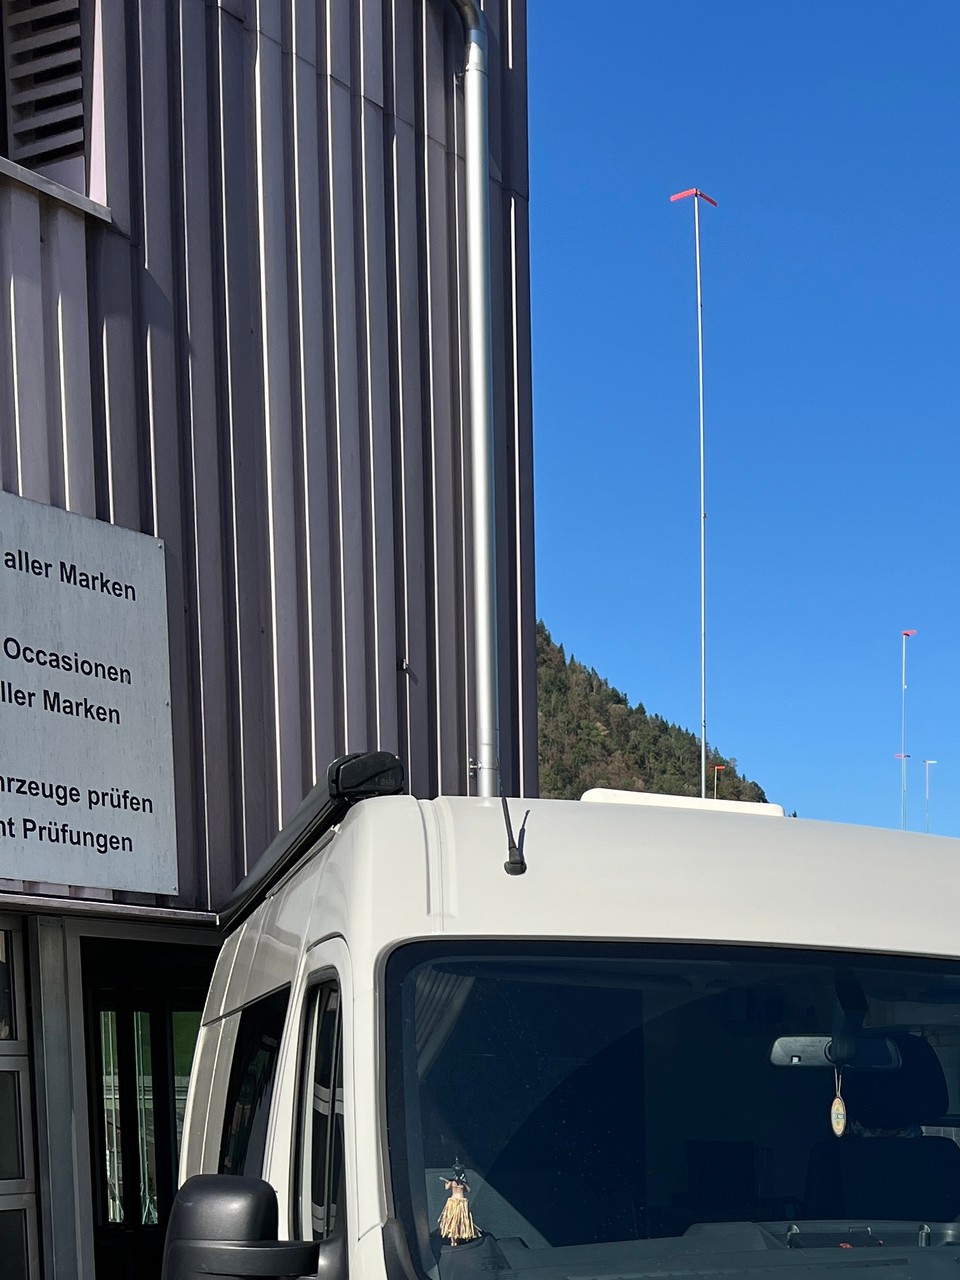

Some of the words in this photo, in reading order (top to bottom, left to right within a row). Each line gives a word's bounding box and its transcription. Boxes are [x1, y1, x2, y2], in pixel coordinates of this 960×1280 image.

[4, 549, 53, 579] aller
[59, 561, 137, 602] Marken
[3, 636, 133, 685] Occasionen
[43, 689, 121, 725] Marken
[87, 784, 154, 815] prüfen
[22, 818, 134, 855] Prüfungen
